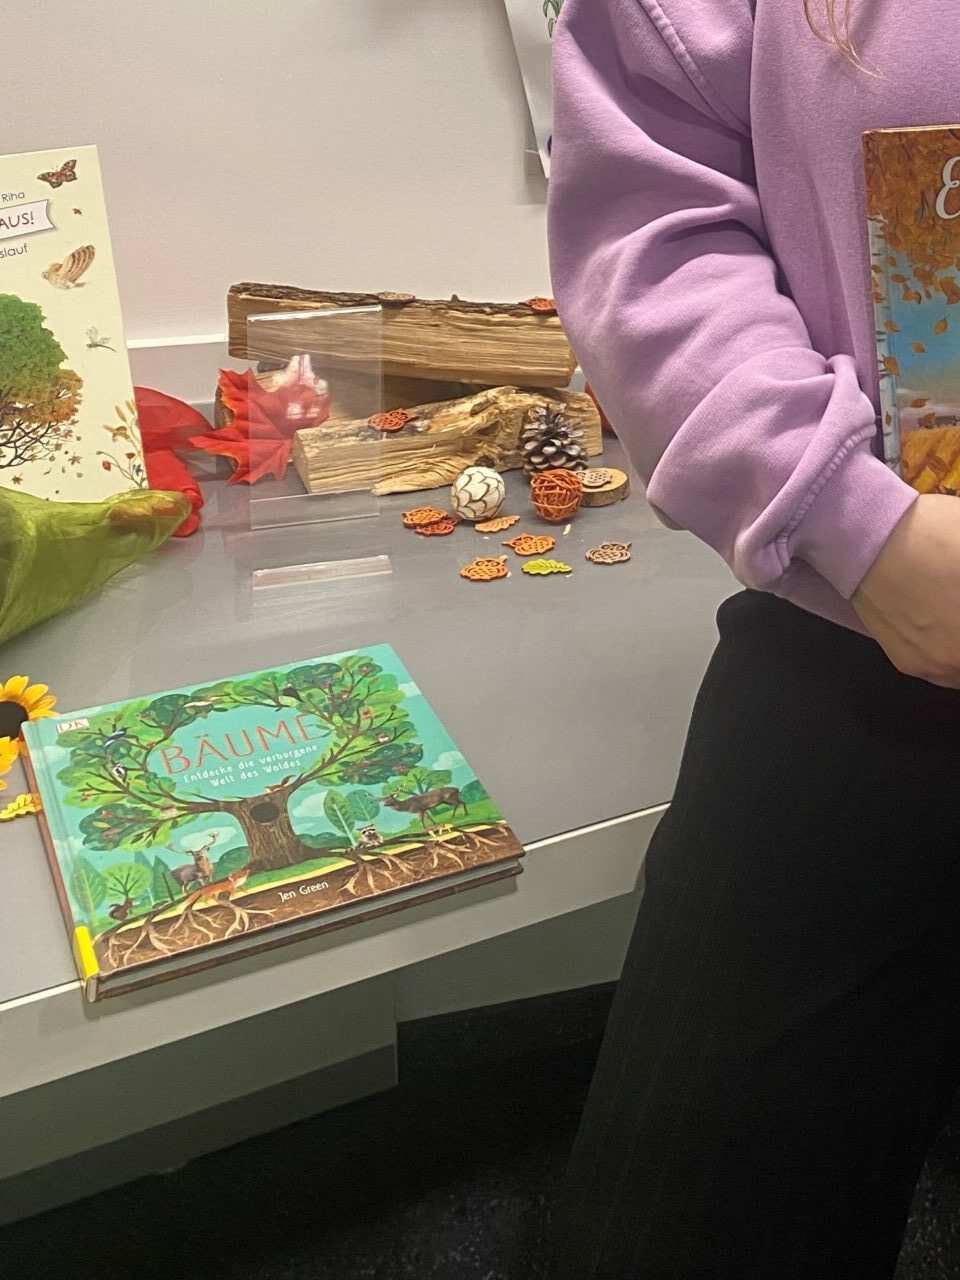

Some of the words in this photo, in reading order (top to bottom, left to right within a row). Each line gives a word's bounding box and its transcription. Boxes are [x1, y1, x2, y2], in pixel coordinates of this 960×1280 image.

[1, 191, 25, 202] Riha
[159, 713, 325, 776] BÄUME
[183, 764, 233, 783] Entdecke
[238, 759, 254, 769] die
[258, 743, 319, 765] verborgene
[209, 775, 236, 787] Welt
[240, 769, 259, 780] des
[262, 760, 302, 774] Waldes
[277, 890, 297, 903] Jen
[299, 881, 329, 895] Green
